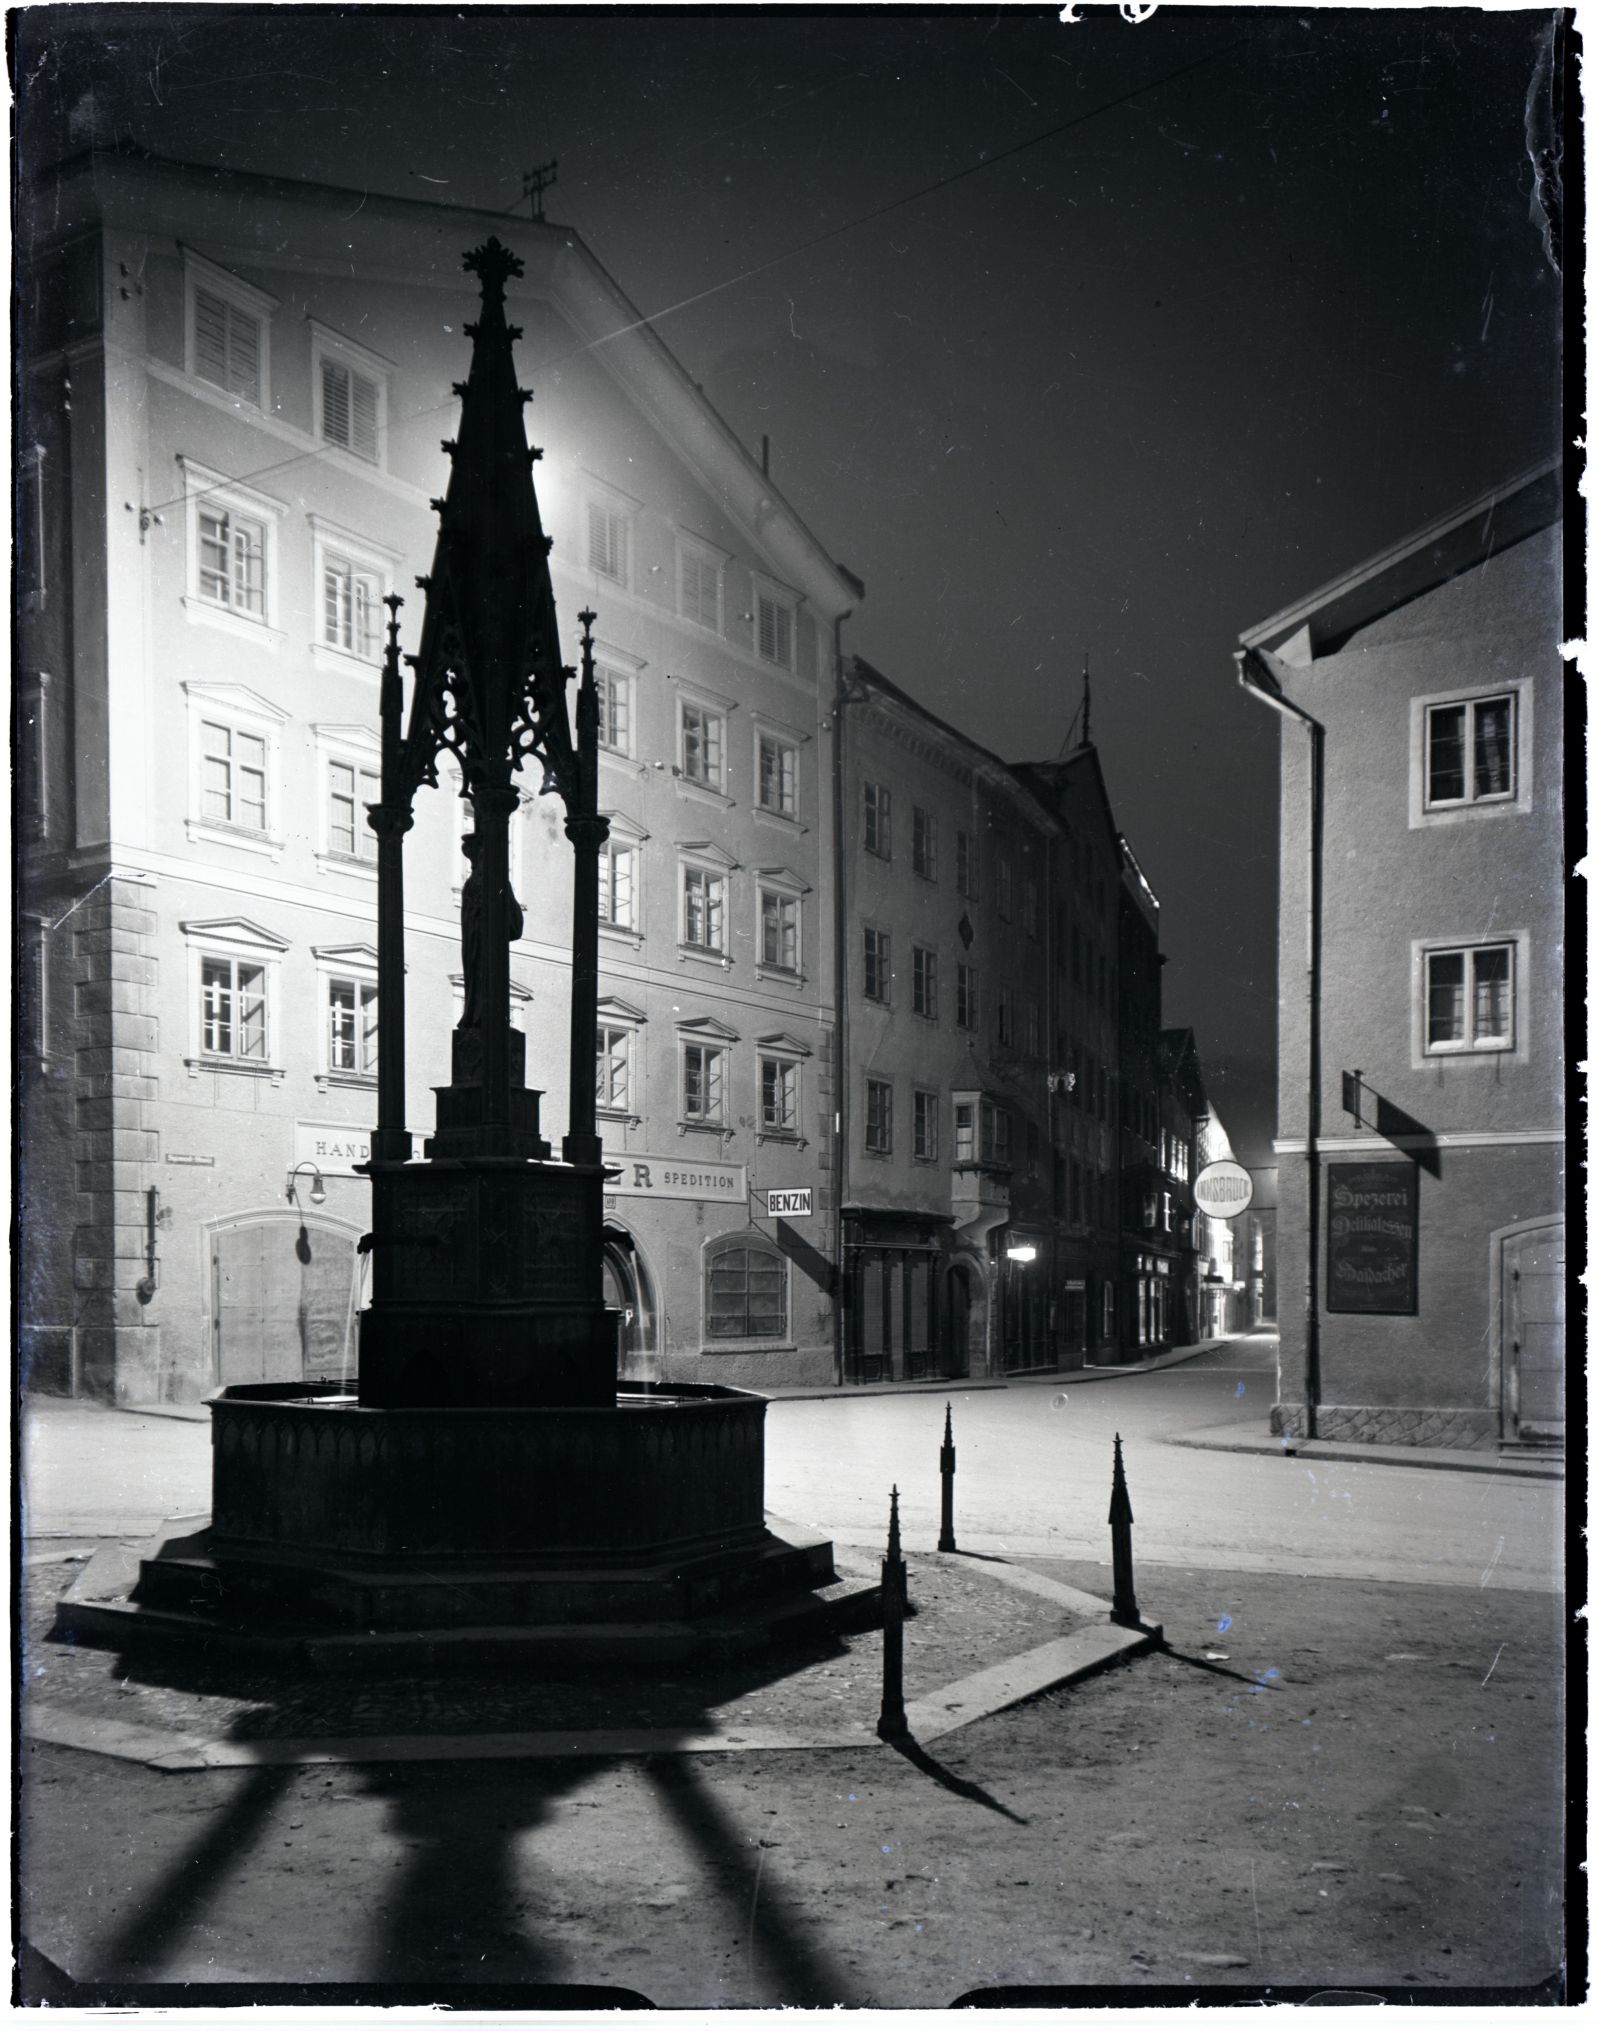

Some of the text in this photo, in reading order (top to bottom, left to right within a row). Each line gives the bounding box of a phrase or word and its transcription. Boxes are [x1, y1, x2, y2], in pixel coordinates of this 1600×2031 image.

[664, 1171, 734, 1188] SPEDITION
[1197, 1176, 1250, 1203] INNSBRUCK
[769, 1193, 811, 1212] BENZIN
[1332, 1184, 1408, 1210] Spezerei
